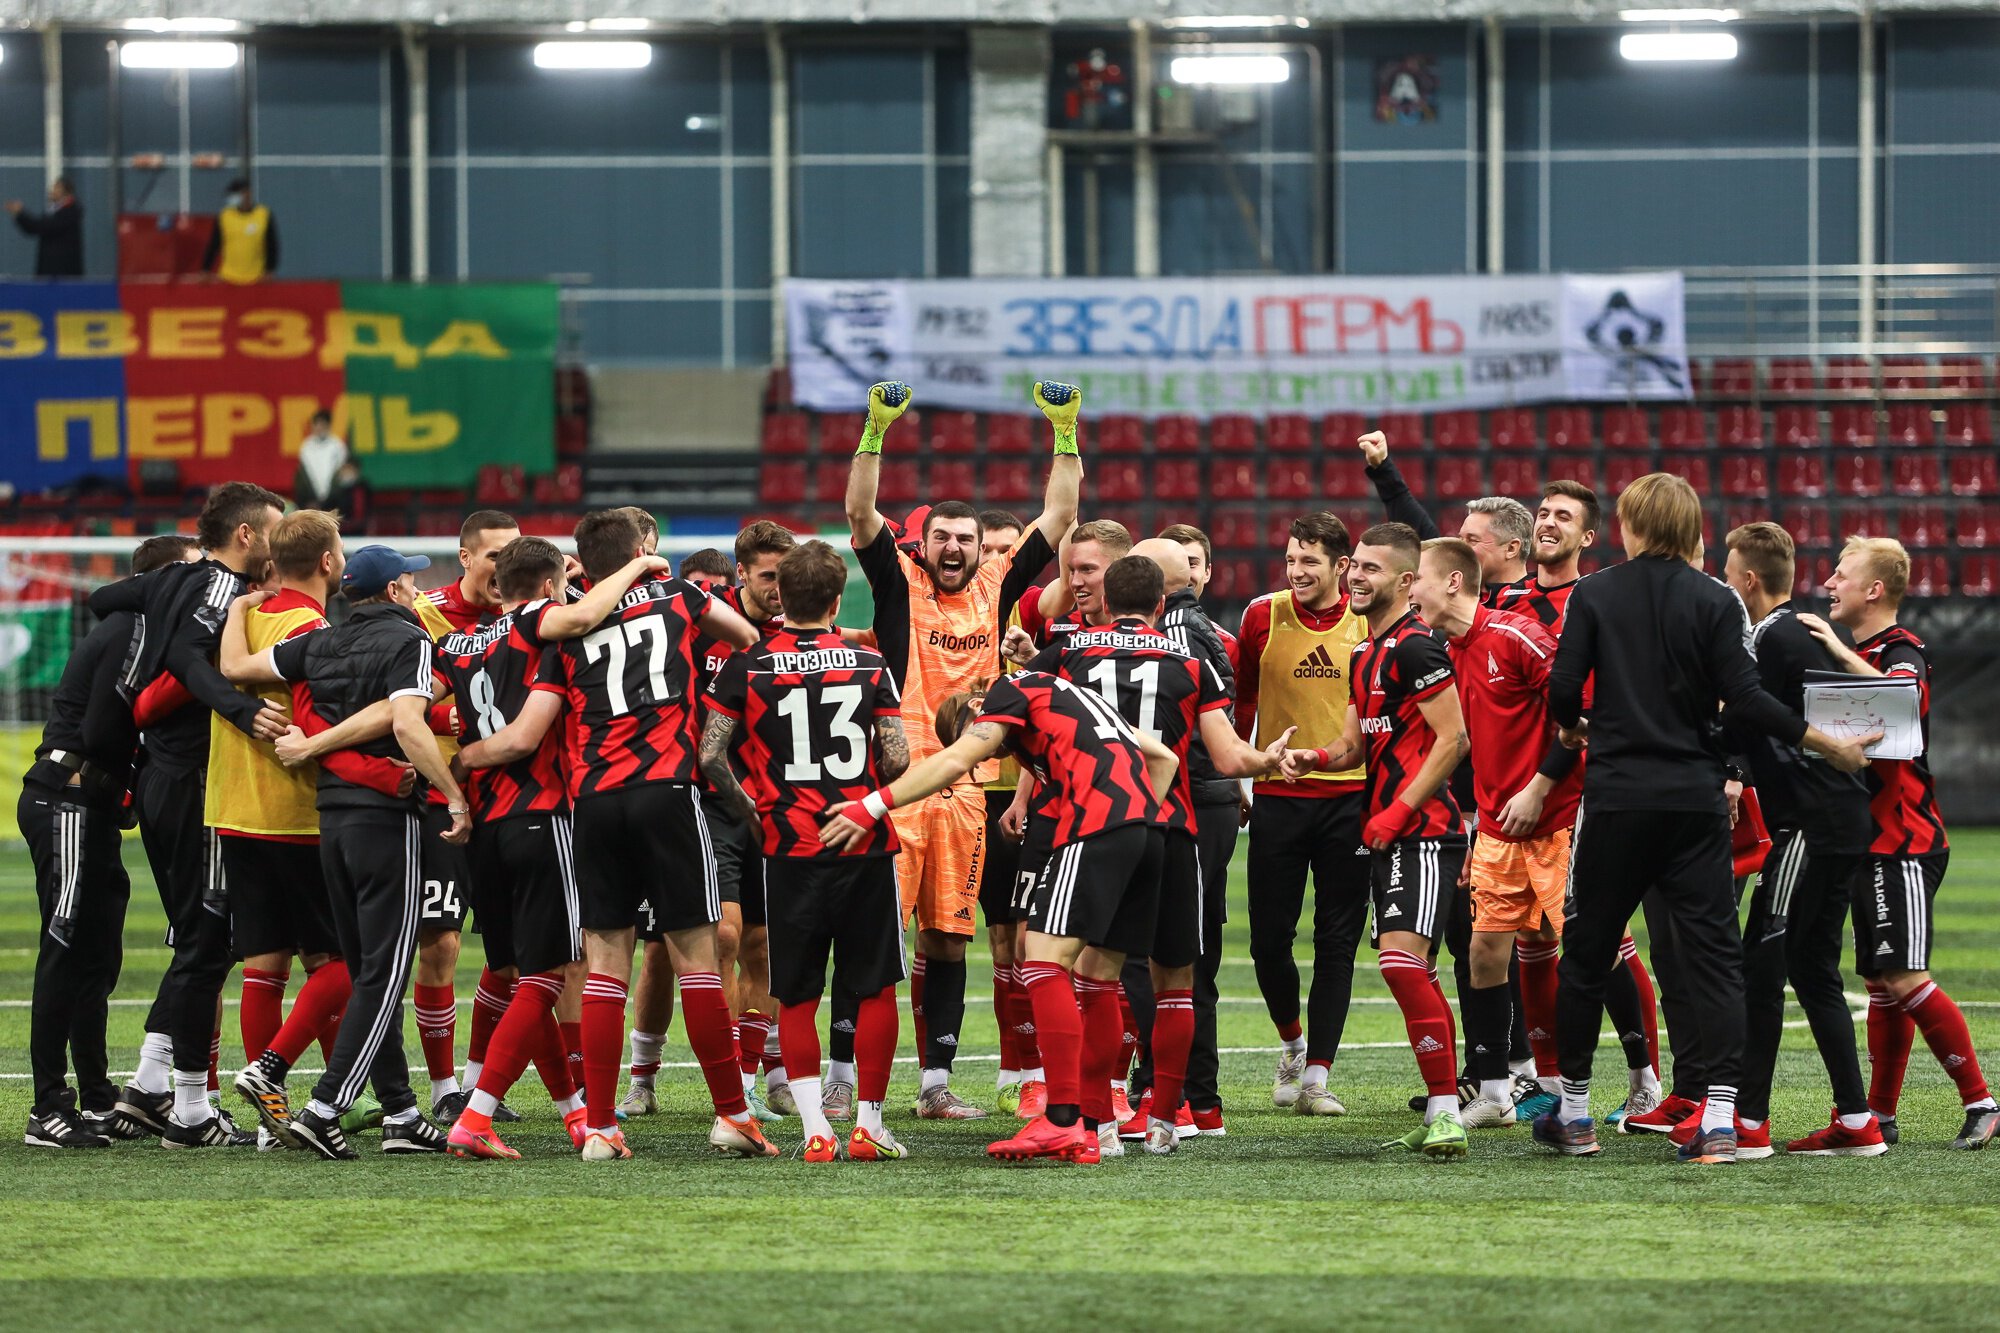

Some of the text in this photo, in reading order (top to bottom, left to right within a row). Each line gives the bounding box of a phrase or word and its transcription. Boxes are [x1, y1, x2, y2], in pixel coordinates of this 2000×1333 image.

[0, 307, 511, 369] ЗВЕЗДА
[1253, 293, 1466, 354] ПЕРМЬ
[36, 393, 460, 461] ПЕРМЬ
[583, 613, 670, 716] 77
[772, 649, 858, 675] ДРОЗДОВ
[1070, 631, 1191, 657] КВЕКВЕСКИРИ
[1293, 665, 1342, 679] adidas
[469, 667, 507, 740] 8
[1088, 659, 1163, 743] 11
[777, 684, 867, 781] 13
[966, 826, 983, 891] sports.ru
[422, 880, 461, 919] 24
[869, 1101, 881, 1111] 13
